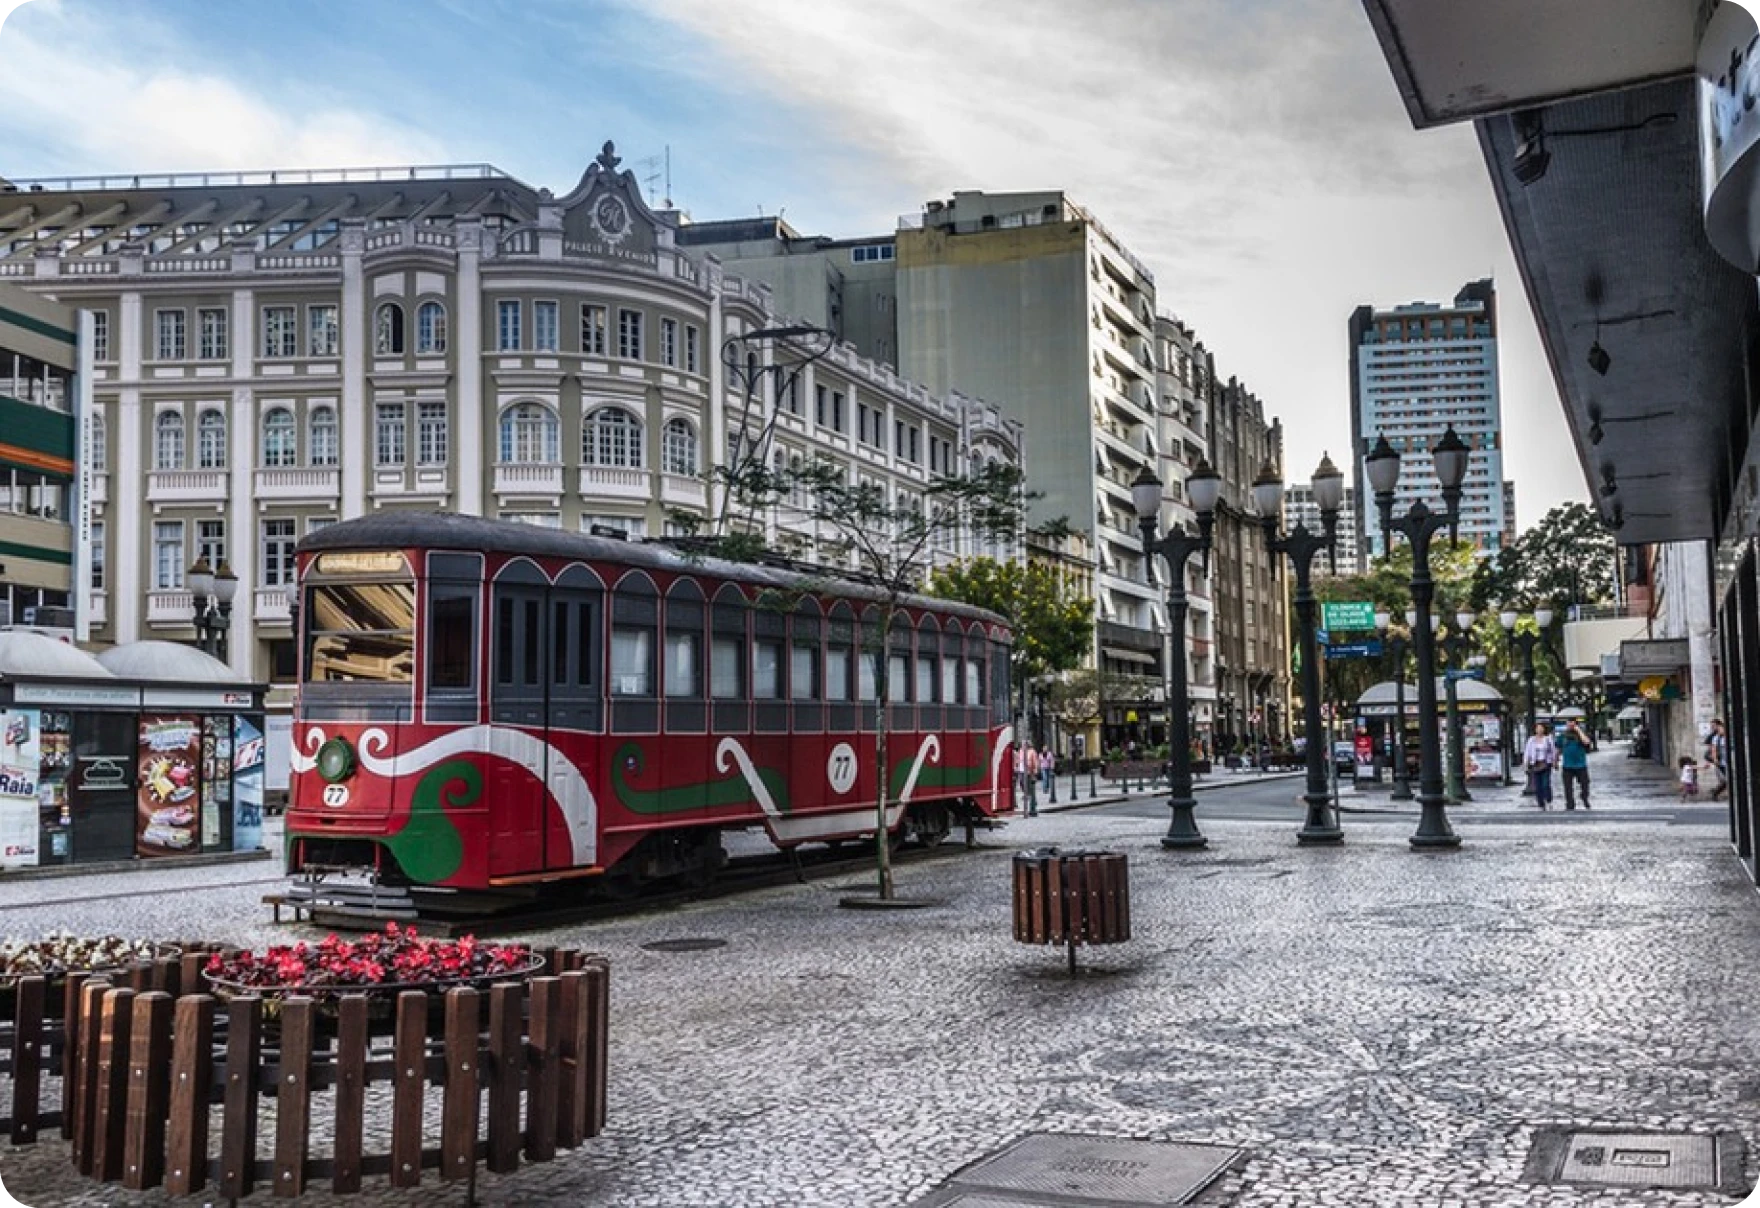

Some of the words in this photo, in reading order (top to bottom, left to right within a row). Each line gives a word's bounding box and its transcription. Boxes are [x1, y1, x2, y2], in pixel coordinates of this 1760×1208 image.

[834, 757, 849, 780] 77
[0, 775, 34, 795] Raia
[327, 787, 345, 803] 77
